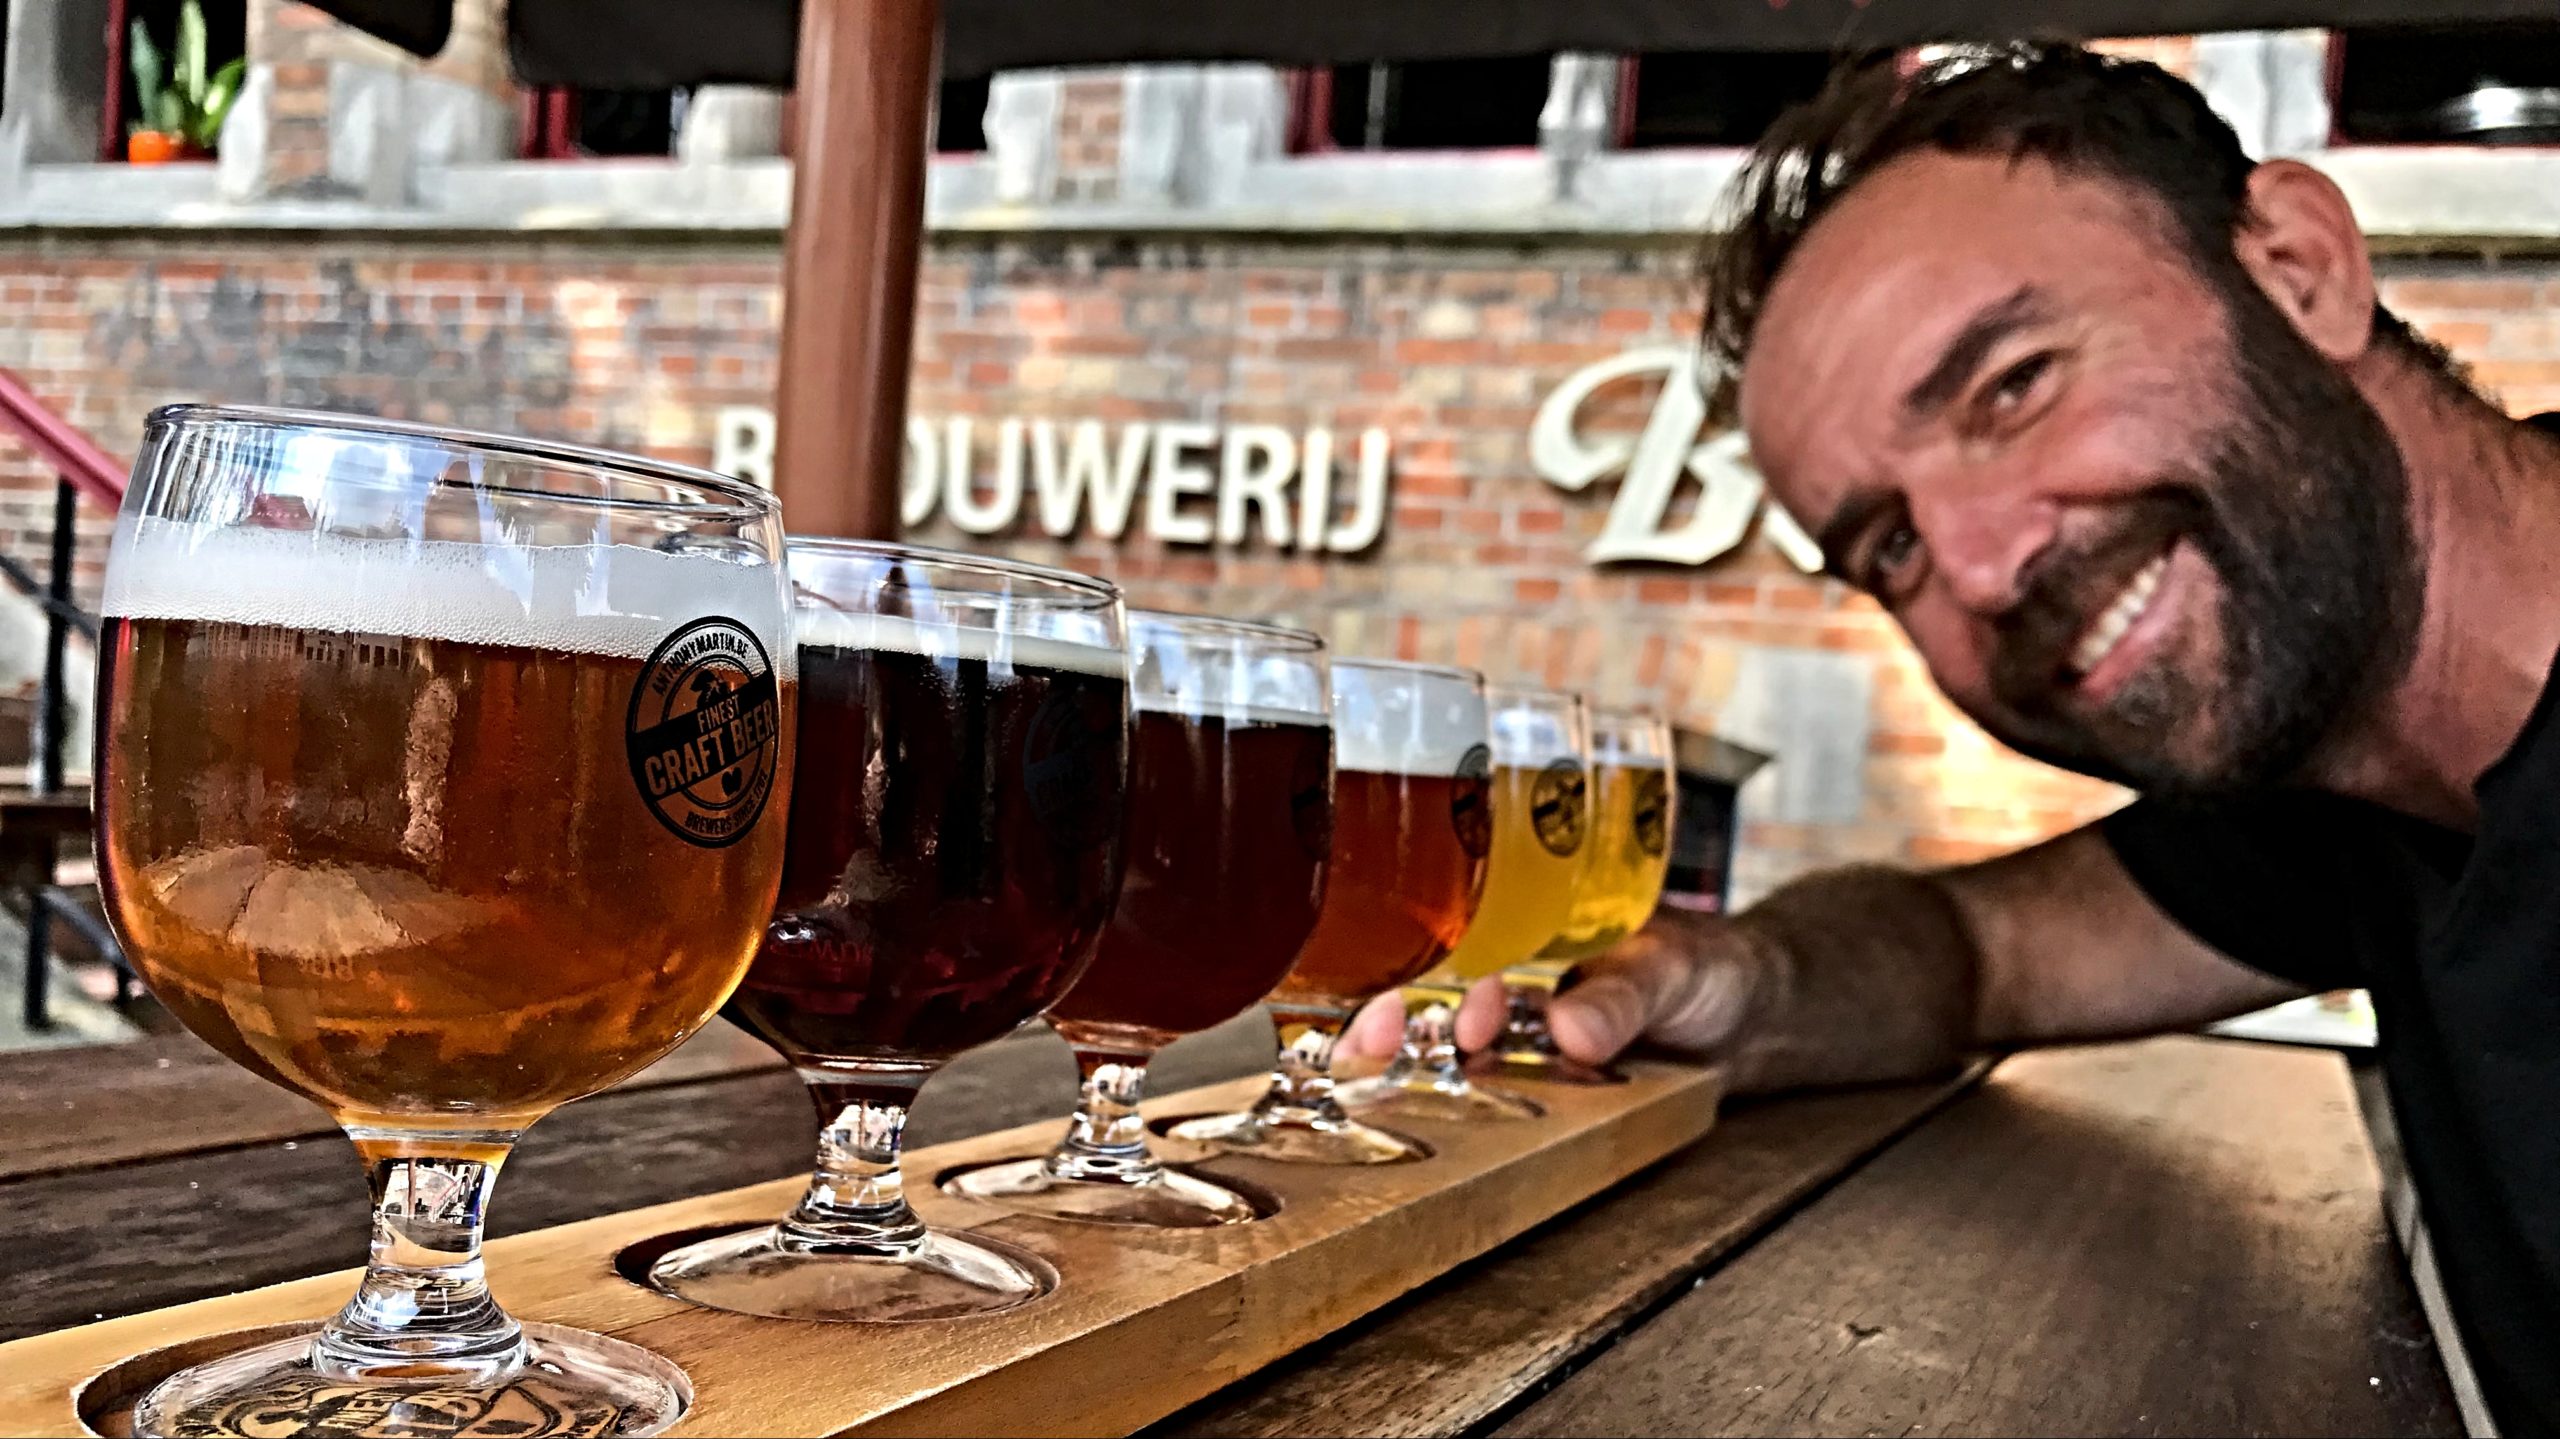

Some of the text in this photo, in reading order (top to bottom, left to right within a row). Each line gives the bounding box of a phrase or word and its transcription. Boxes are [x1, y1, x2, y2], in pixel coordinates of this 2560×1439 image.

[715, 346, 1825, 573] BUWERIJ B
[652, 632, 749, 697] ANTHONYMARTIN.BE
[645, 699, 775, 795] CRAFT BEER
[697, 694, 739, 733] FINEST
